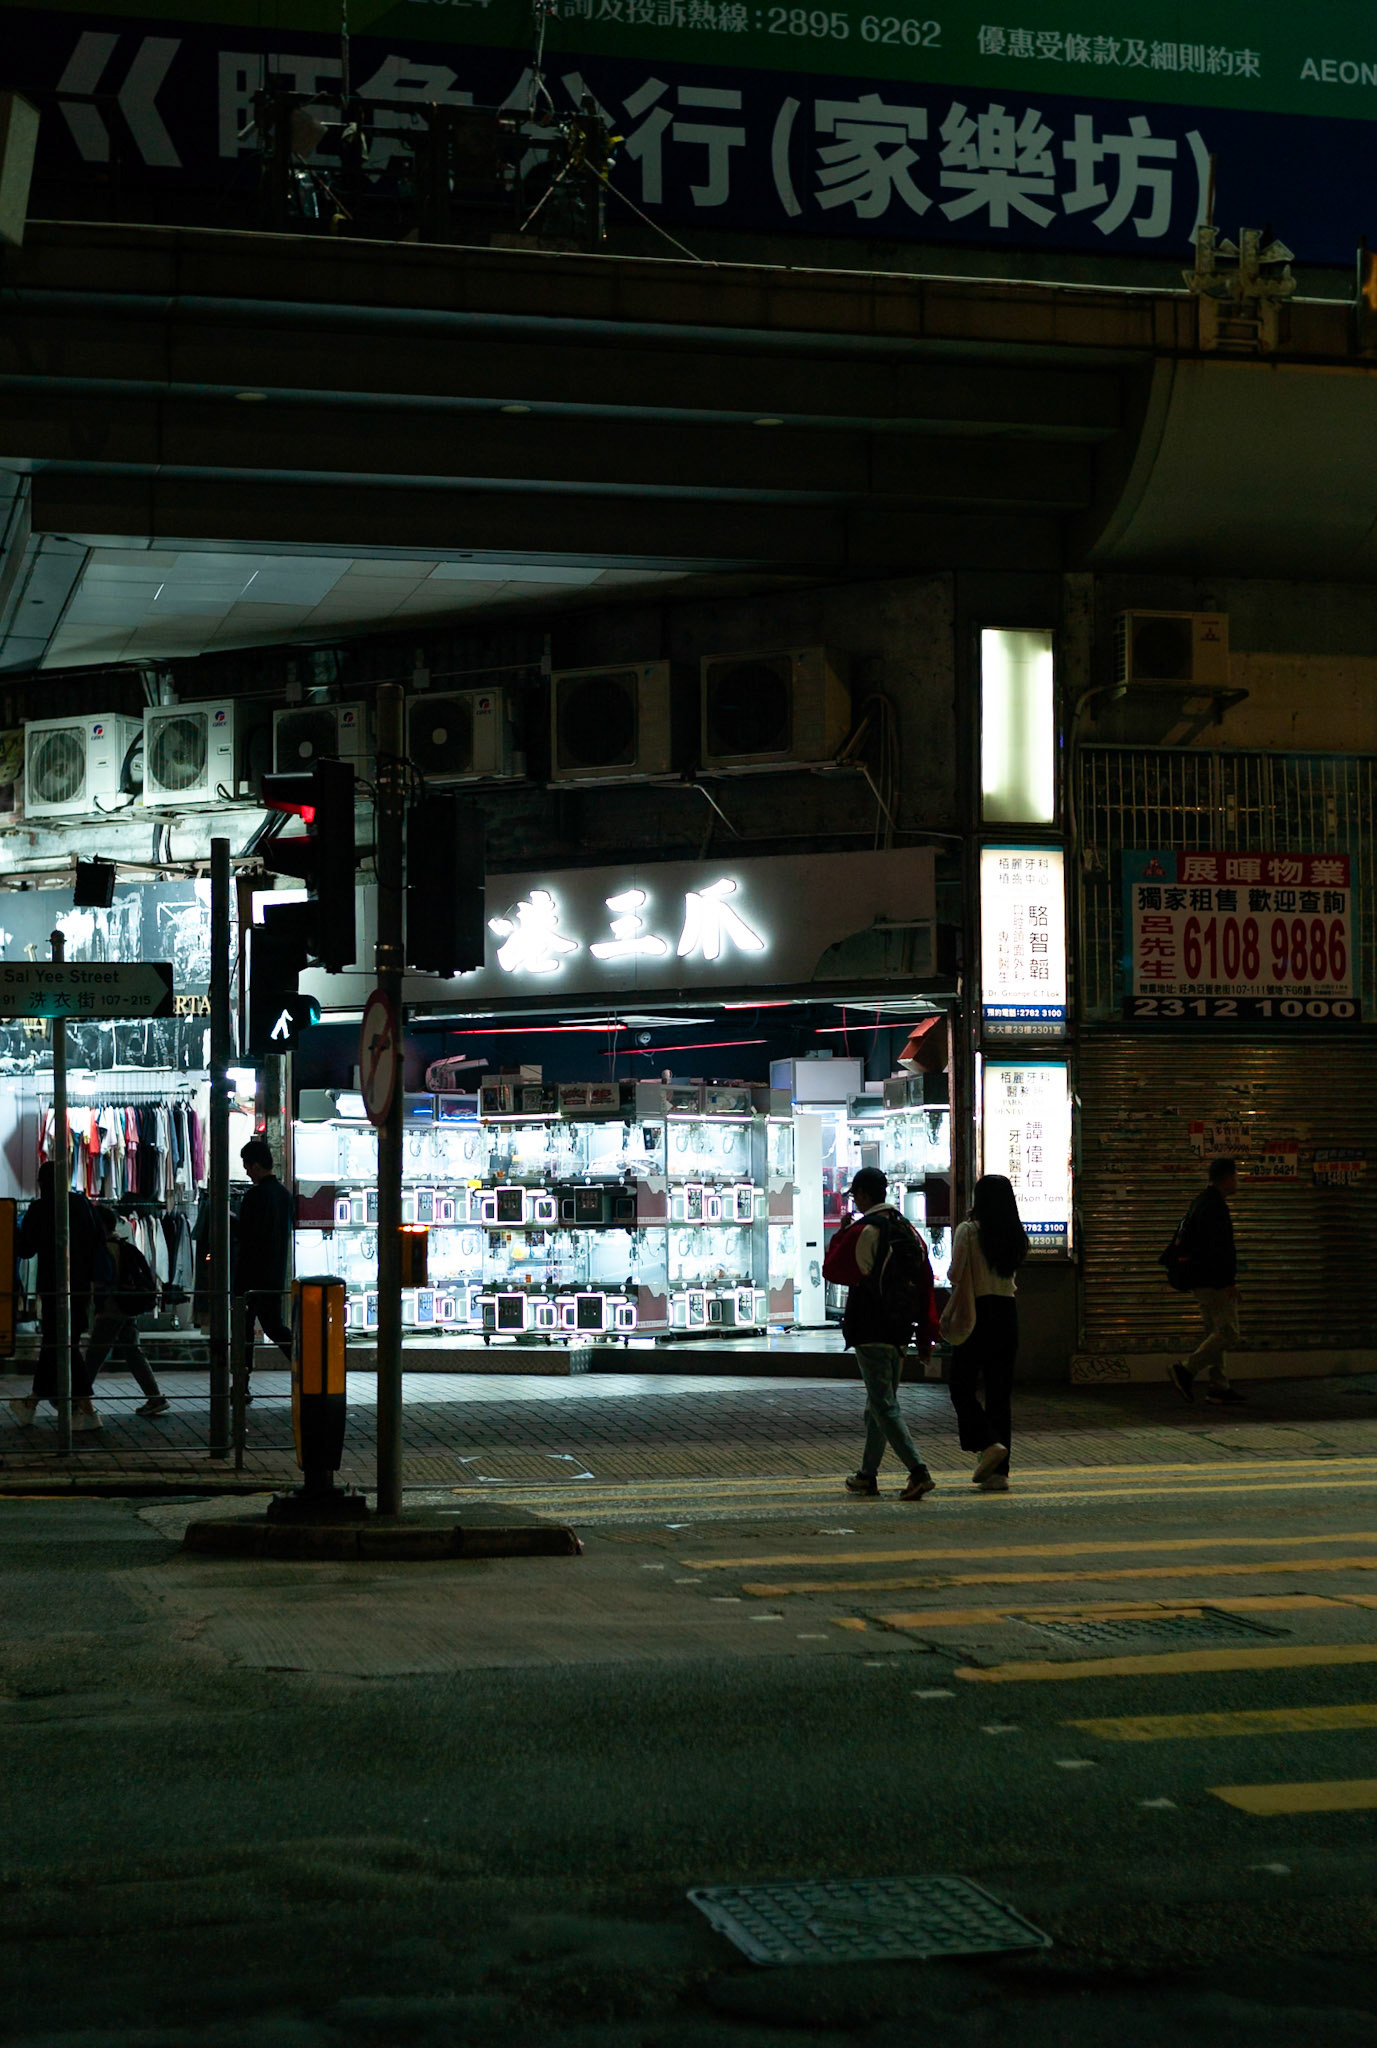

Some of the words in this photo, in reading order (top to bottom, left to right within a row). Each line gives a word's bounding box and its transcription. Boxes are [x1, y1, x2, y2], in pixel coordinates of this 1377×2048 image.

[860, 15, 942, 48] 6262
[977, 24, 1261, 78] 優惠受條款及細則約束
[1299, 57, 1377, 87] AEON
[1182, 856, 1345, 885] 展暉物業
[1138, 887, 1238, 912] 獨家租售
[1248, 889, 1346, 914] 歡迎查詢
[1139, 916, 1176, 979] 呂先生
[1183, 917, 1260, 979] 6108
[1271, 918, 1347, 981] 9886
[4, 969, 29, 983] Sai
[35, 969, 64, 983] Yee
[70, 969, 120, 983] Street
[29, 991, 95, 1009] 洗衣街
[1133, 999, 1239, 1017] 2312
[1254, 1000, 1356, 1018] 1000
[1026, 1121, 1043, 1187] 譚偉信
[1044, 1224, 1064, 1232] 3100
